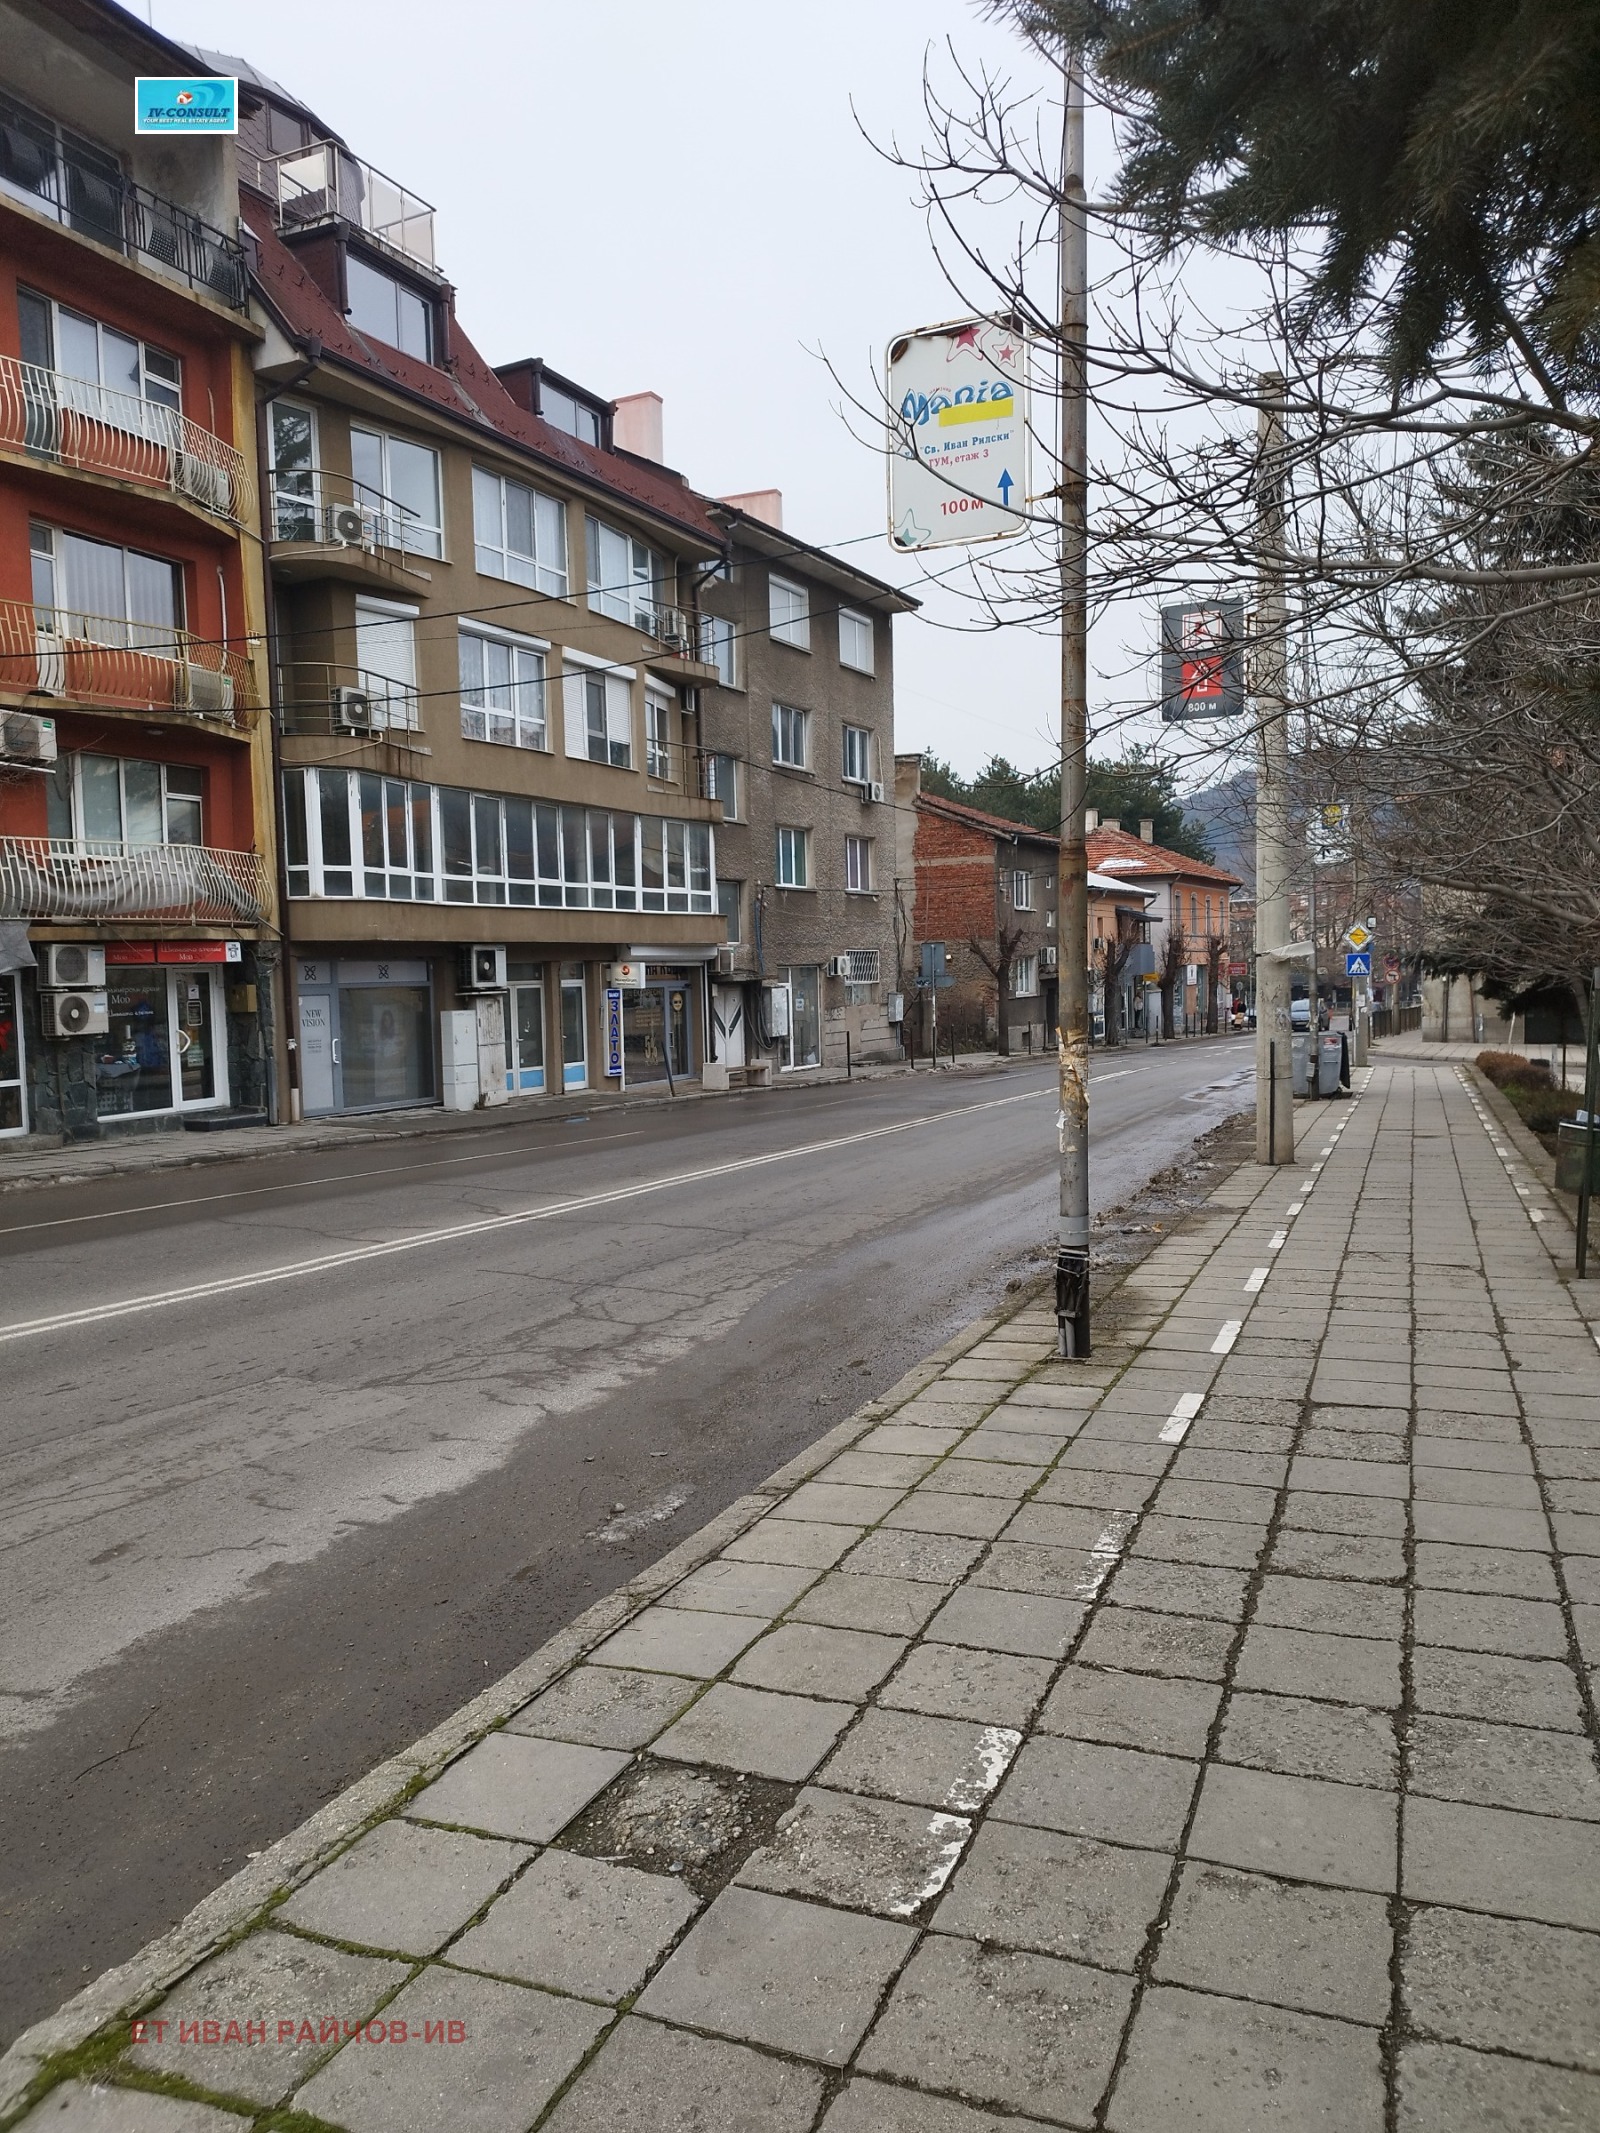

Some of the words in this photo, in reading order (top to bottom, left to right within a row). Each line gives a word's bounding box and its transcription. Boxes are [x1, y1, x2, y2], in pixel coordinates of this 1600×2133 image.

[943, 440, 968, 452] Иван
[954, 451, 980, 463] етаж
[983, 448, 989, 459] 3
[940, 499, 968, 516] 100
[305, 1009, 322, 1018] NEW
[301, 1018, 326, 1027] VISION
[611, 1000, 619, 1064] ЗЛАТО
